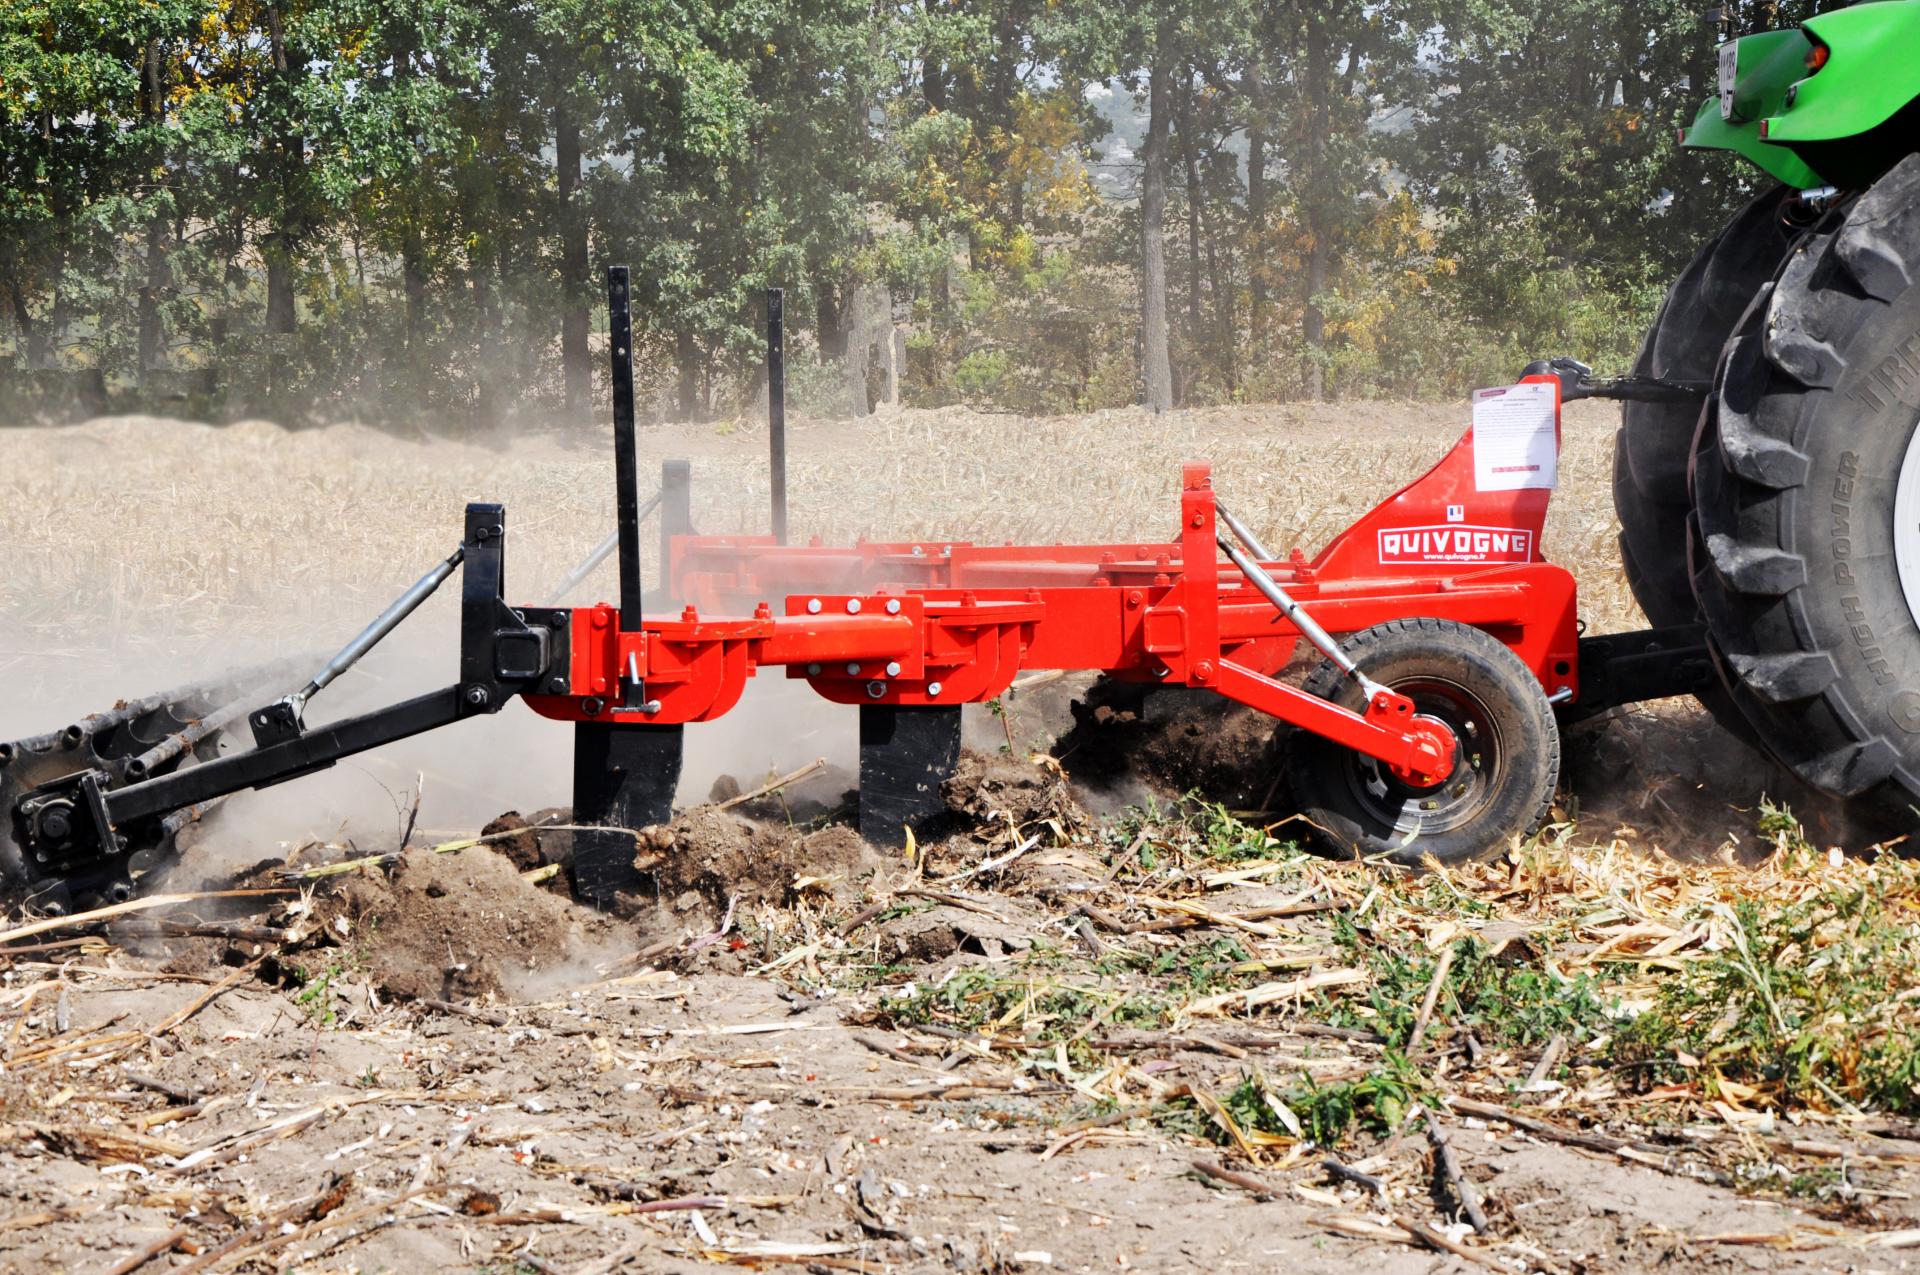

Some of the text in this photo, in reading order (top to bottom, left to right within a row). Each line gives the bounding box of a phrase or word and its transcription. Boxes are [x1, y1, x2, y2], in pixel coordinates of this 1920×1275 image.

[1384, 531, 1525, 555] QUIVOGNE
[1423, 553, 1486, 562] www.quivogne.fr
[1831, 450, 1896, 686] HIGH POWER
